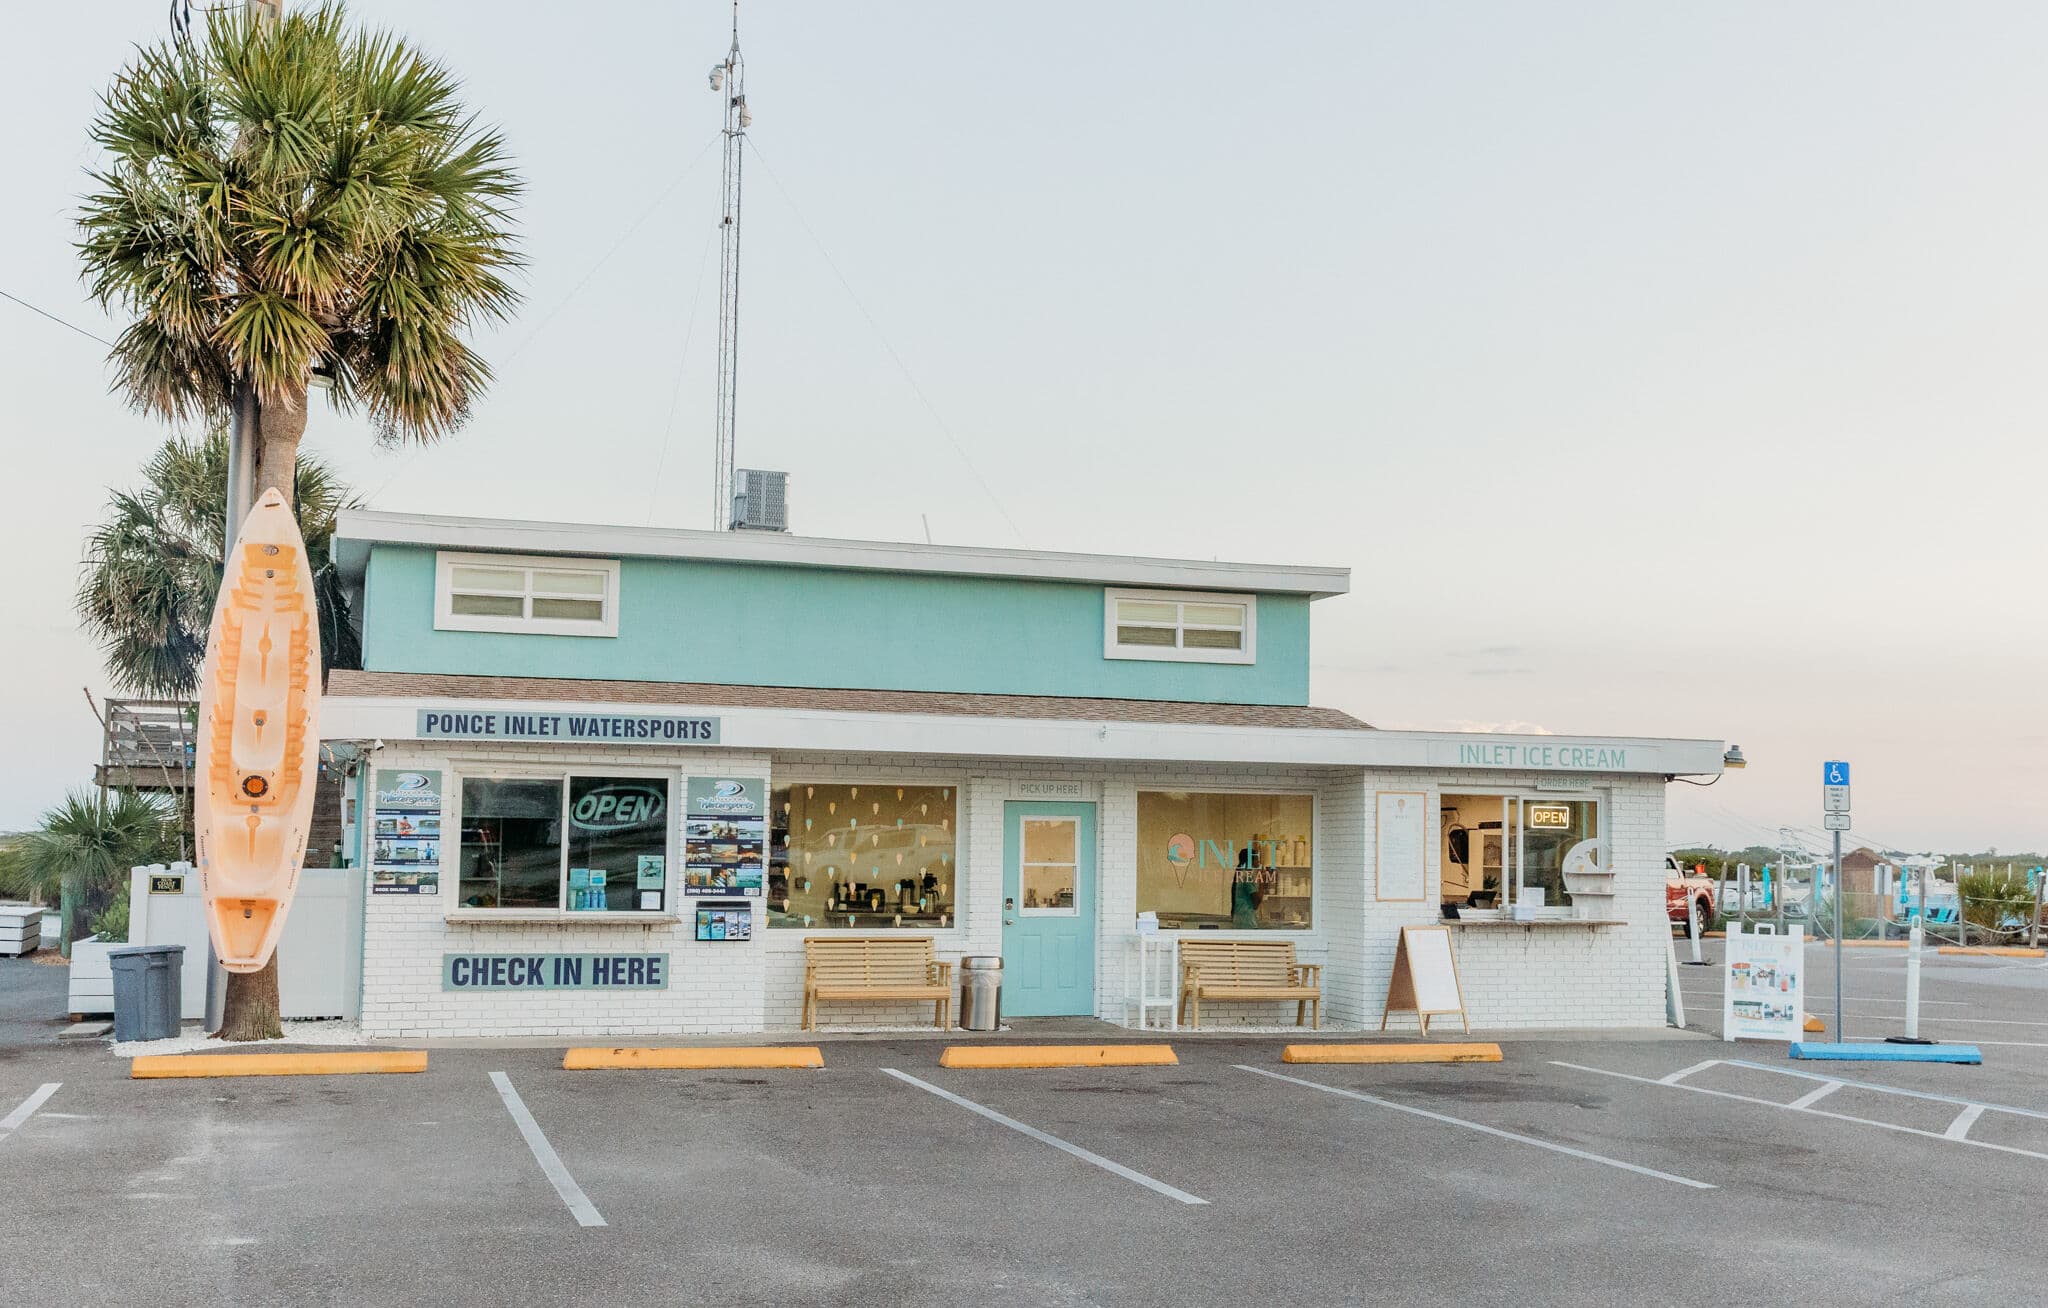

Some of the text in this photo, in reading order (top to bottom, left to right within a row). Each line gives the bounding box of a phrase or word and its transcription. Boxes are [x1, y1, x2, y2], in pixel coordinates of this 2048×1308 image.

[425, 713, 713, 740] PONCE INLET WATERSPORTS
[1460, 744, 1626, 769] INLET ICE CREAM
[1020, 783, 1079, 794] PICK UP HERE
[1541, 777, 1590, 788] ORDER HERE
[575, 794, 656, 821] OPEN
[1534, 811, 1567, 824] OPEN
[1199, 839, 1284, 870] INLET
[452, 957, 662, 986] CHECK IN HERE
